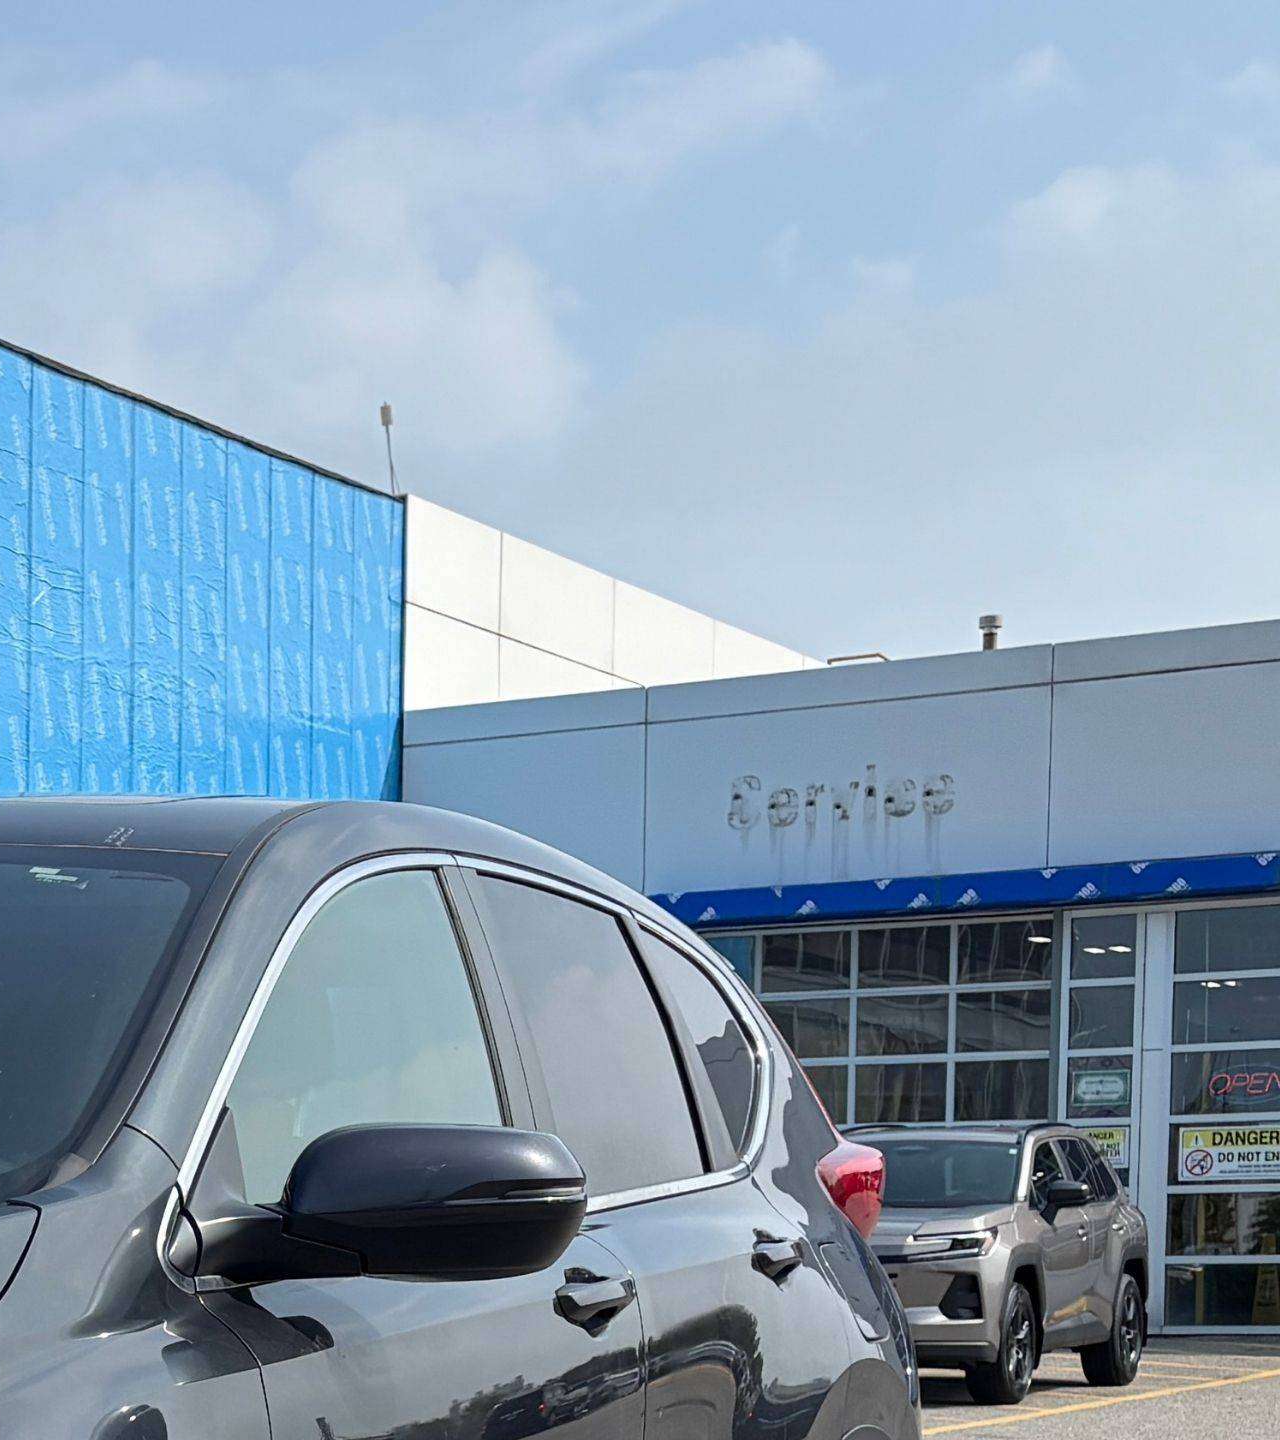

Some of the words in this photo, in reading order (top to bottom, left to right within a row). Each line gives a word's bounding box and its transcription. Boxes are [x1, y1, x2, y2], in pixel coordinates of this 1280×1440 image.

[1212, 1130, 1280, 1146] DANGER
[1218, 1153, 1235, 1163] DO
[1238, 1152, 1262, 1163] NOT
